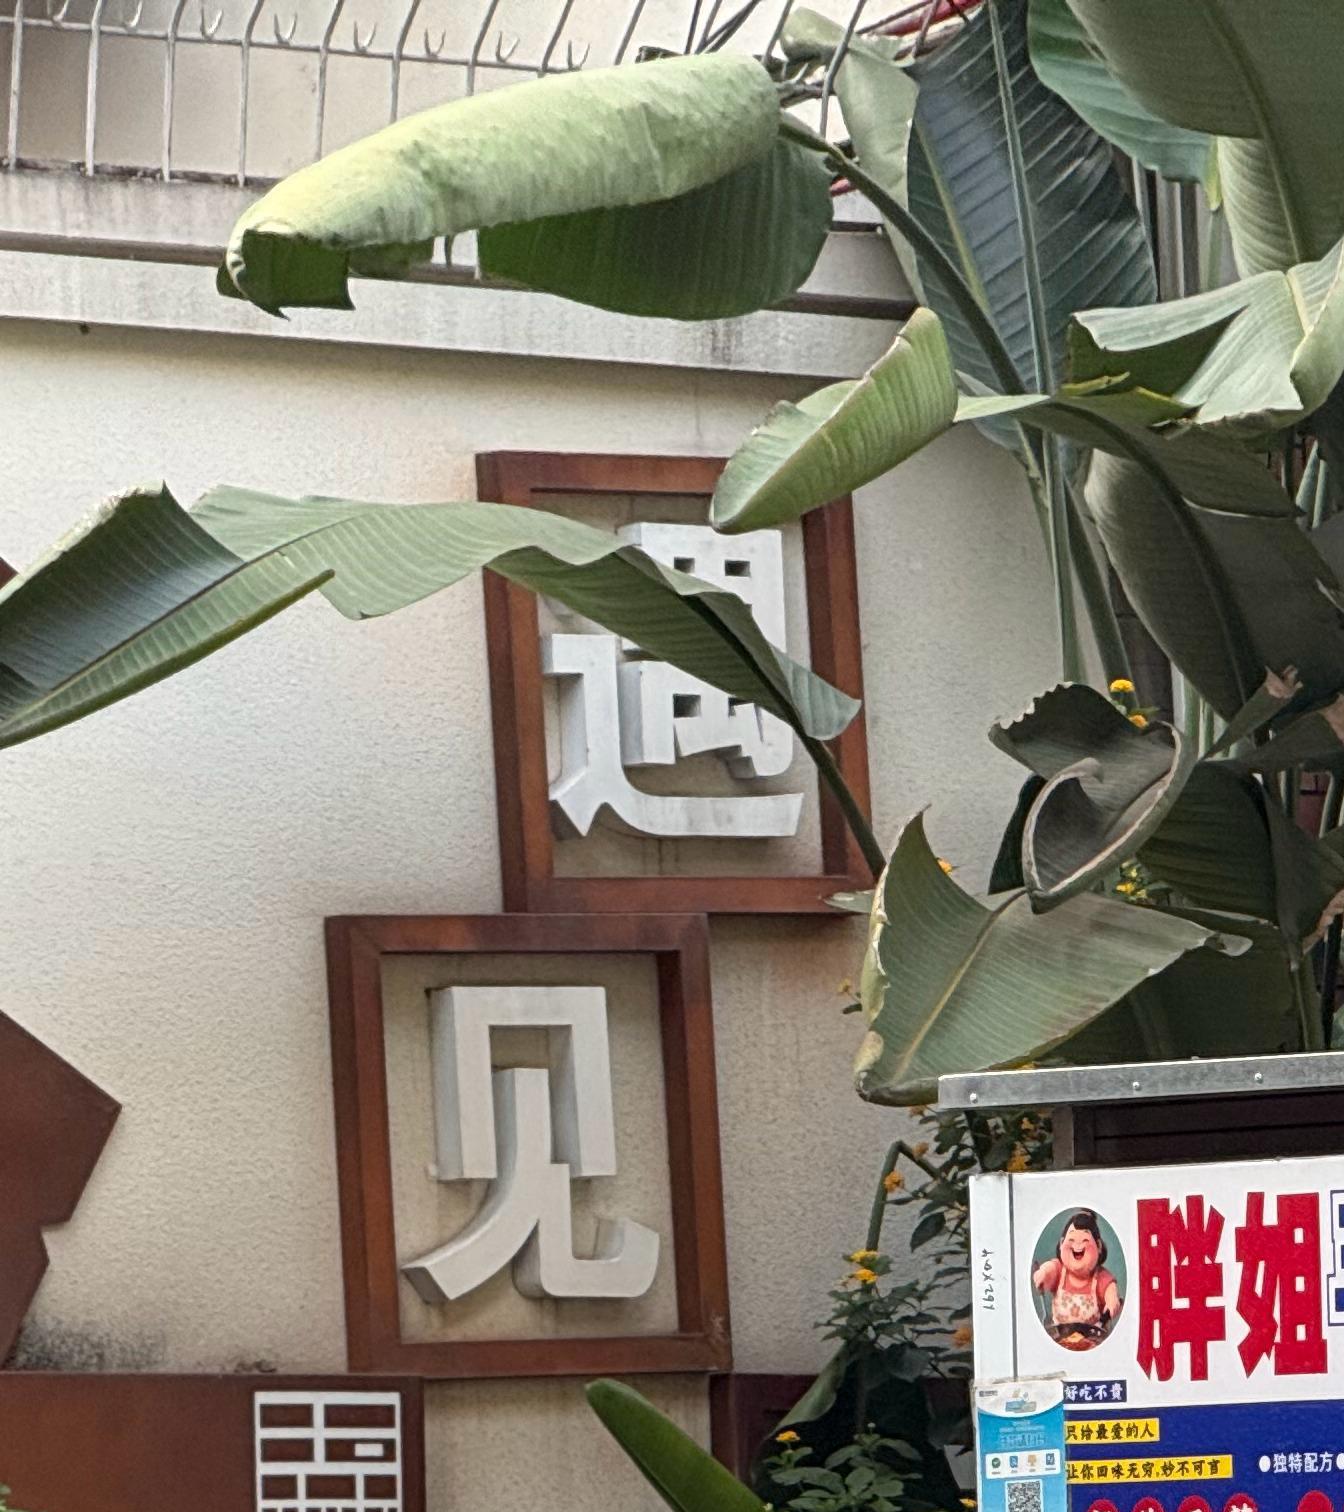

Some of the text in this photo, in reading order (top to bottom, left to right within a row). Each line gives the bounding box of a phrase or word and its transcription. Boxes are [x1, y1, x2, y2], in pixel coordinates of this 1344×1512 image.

[402, 985, 660, 1301] 见
[1273, 1452, 1334, 1474] 独特配方
